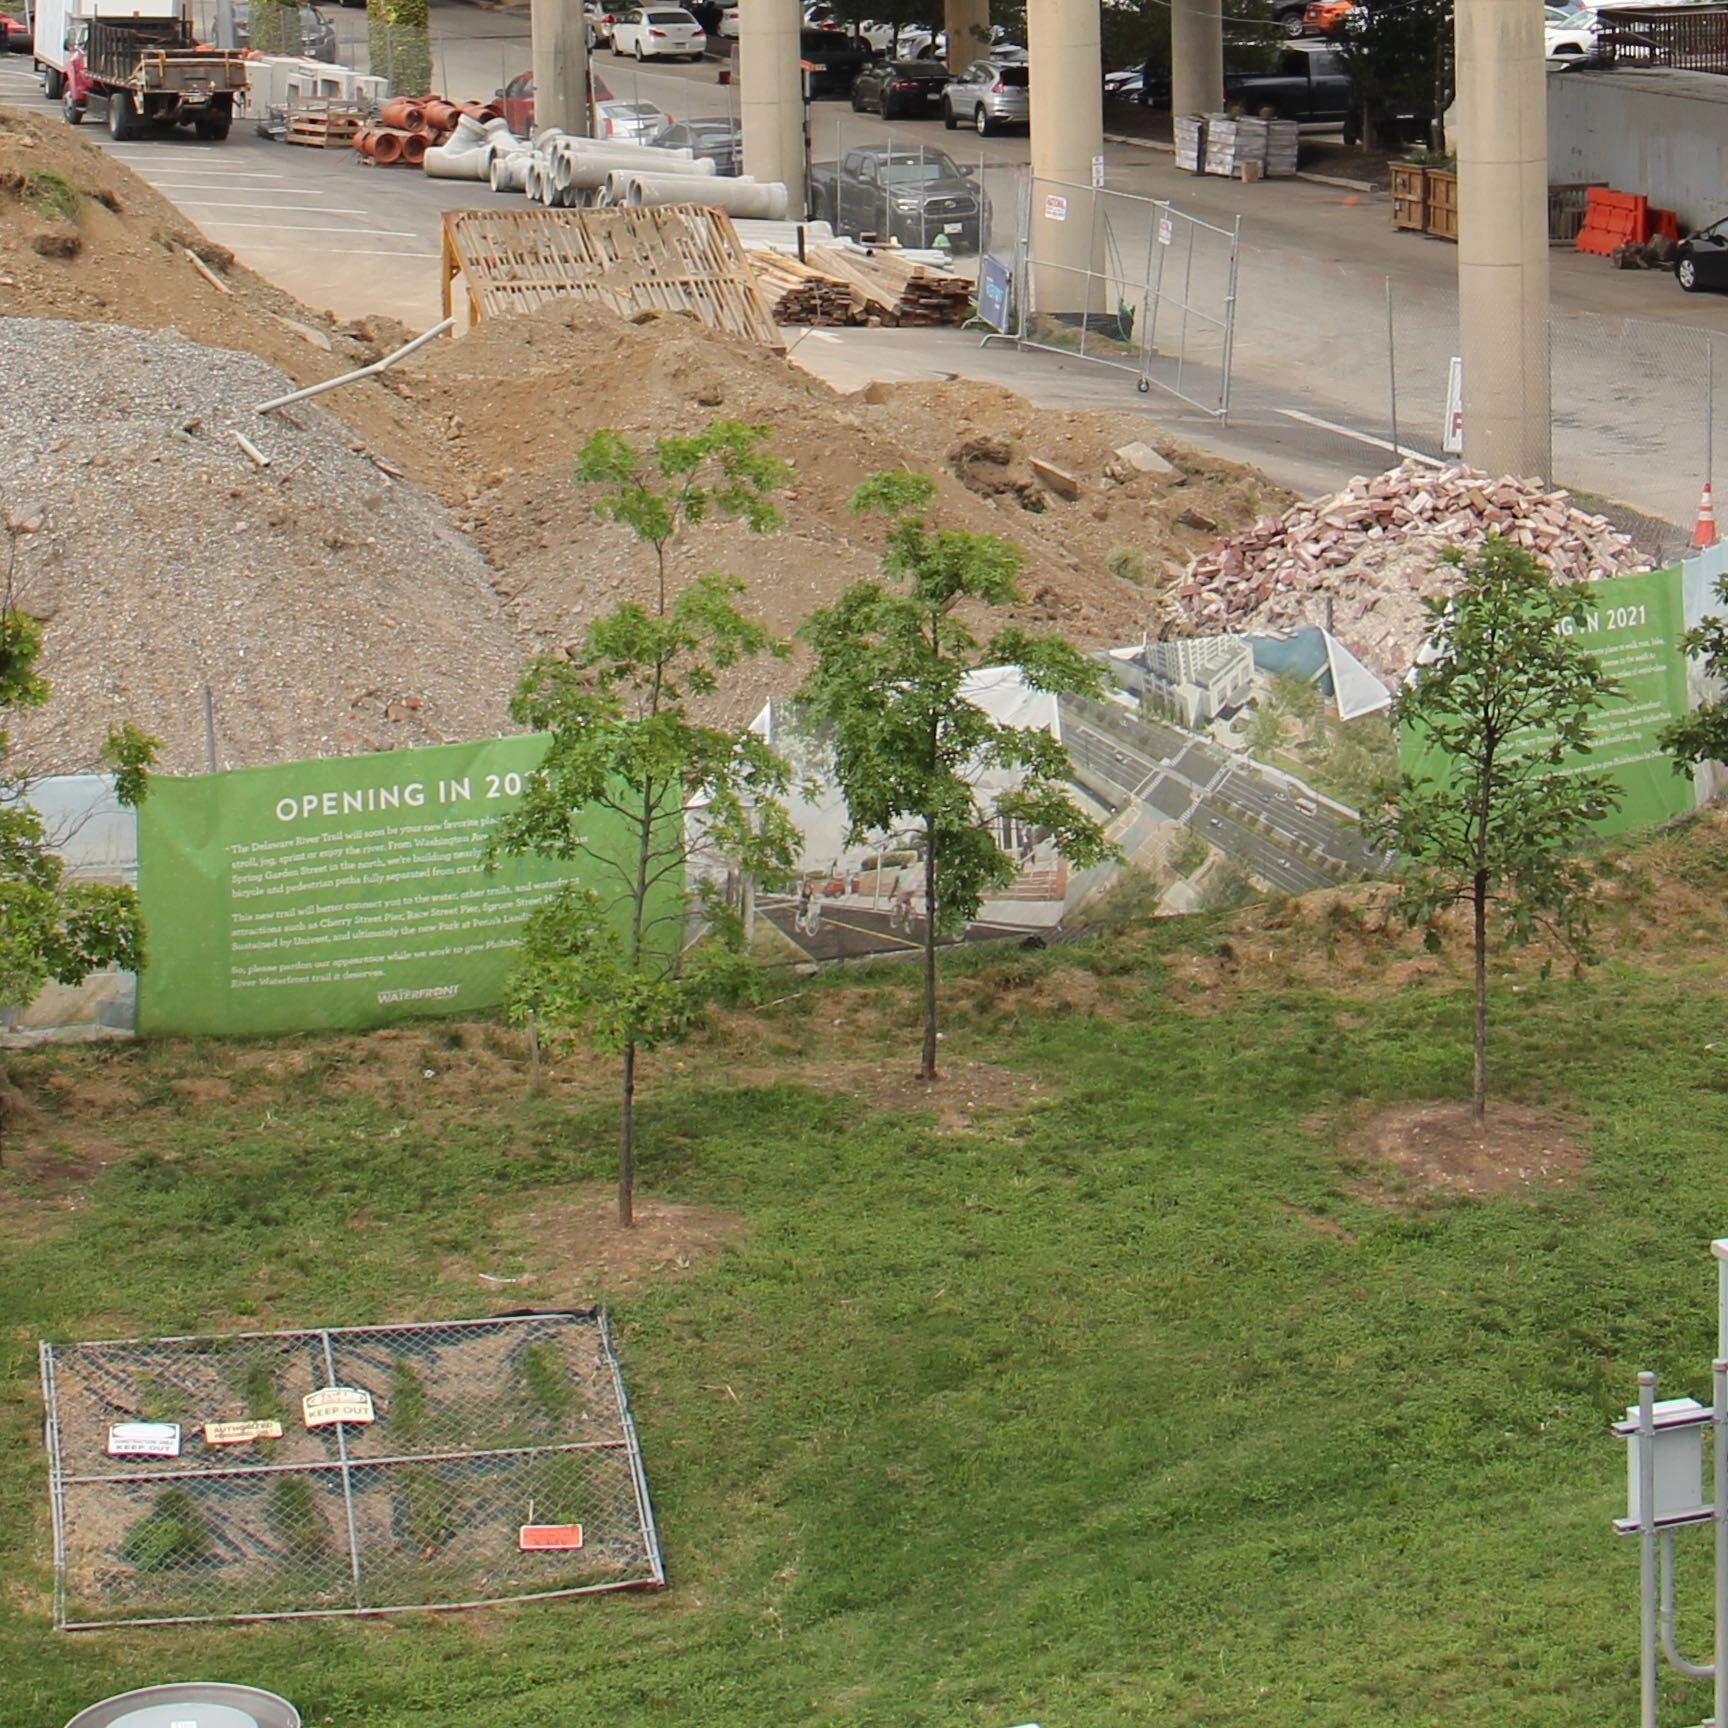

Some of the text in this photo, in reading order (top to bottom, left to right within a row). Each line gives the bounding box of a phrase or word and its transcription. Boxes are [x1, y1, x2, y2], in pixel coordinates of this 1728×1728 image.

[1607, 605, 1646, 630] 2021
[275, 783, 425, 822] OPENING
[438, 777, 472, 804] IN
[295, 835, 320, 846] River
[321, 831, 343, 843] Trail
[414, 835, 469, 848] Washington
[319, 918, 353, 929] Cherry
[354, 914, 383, 925] Street
[430, 906, 458, 918] Street
[482, 900, 514, 913] Spruce
[377, 983, 460, 1004] WATERFRONT
[309, 1406, 370, 1418] KEEP OUT
[213, 1422, 273, 1434] AUTHORIZED
[115, 1444, 171, 1453] KEEP OUT
